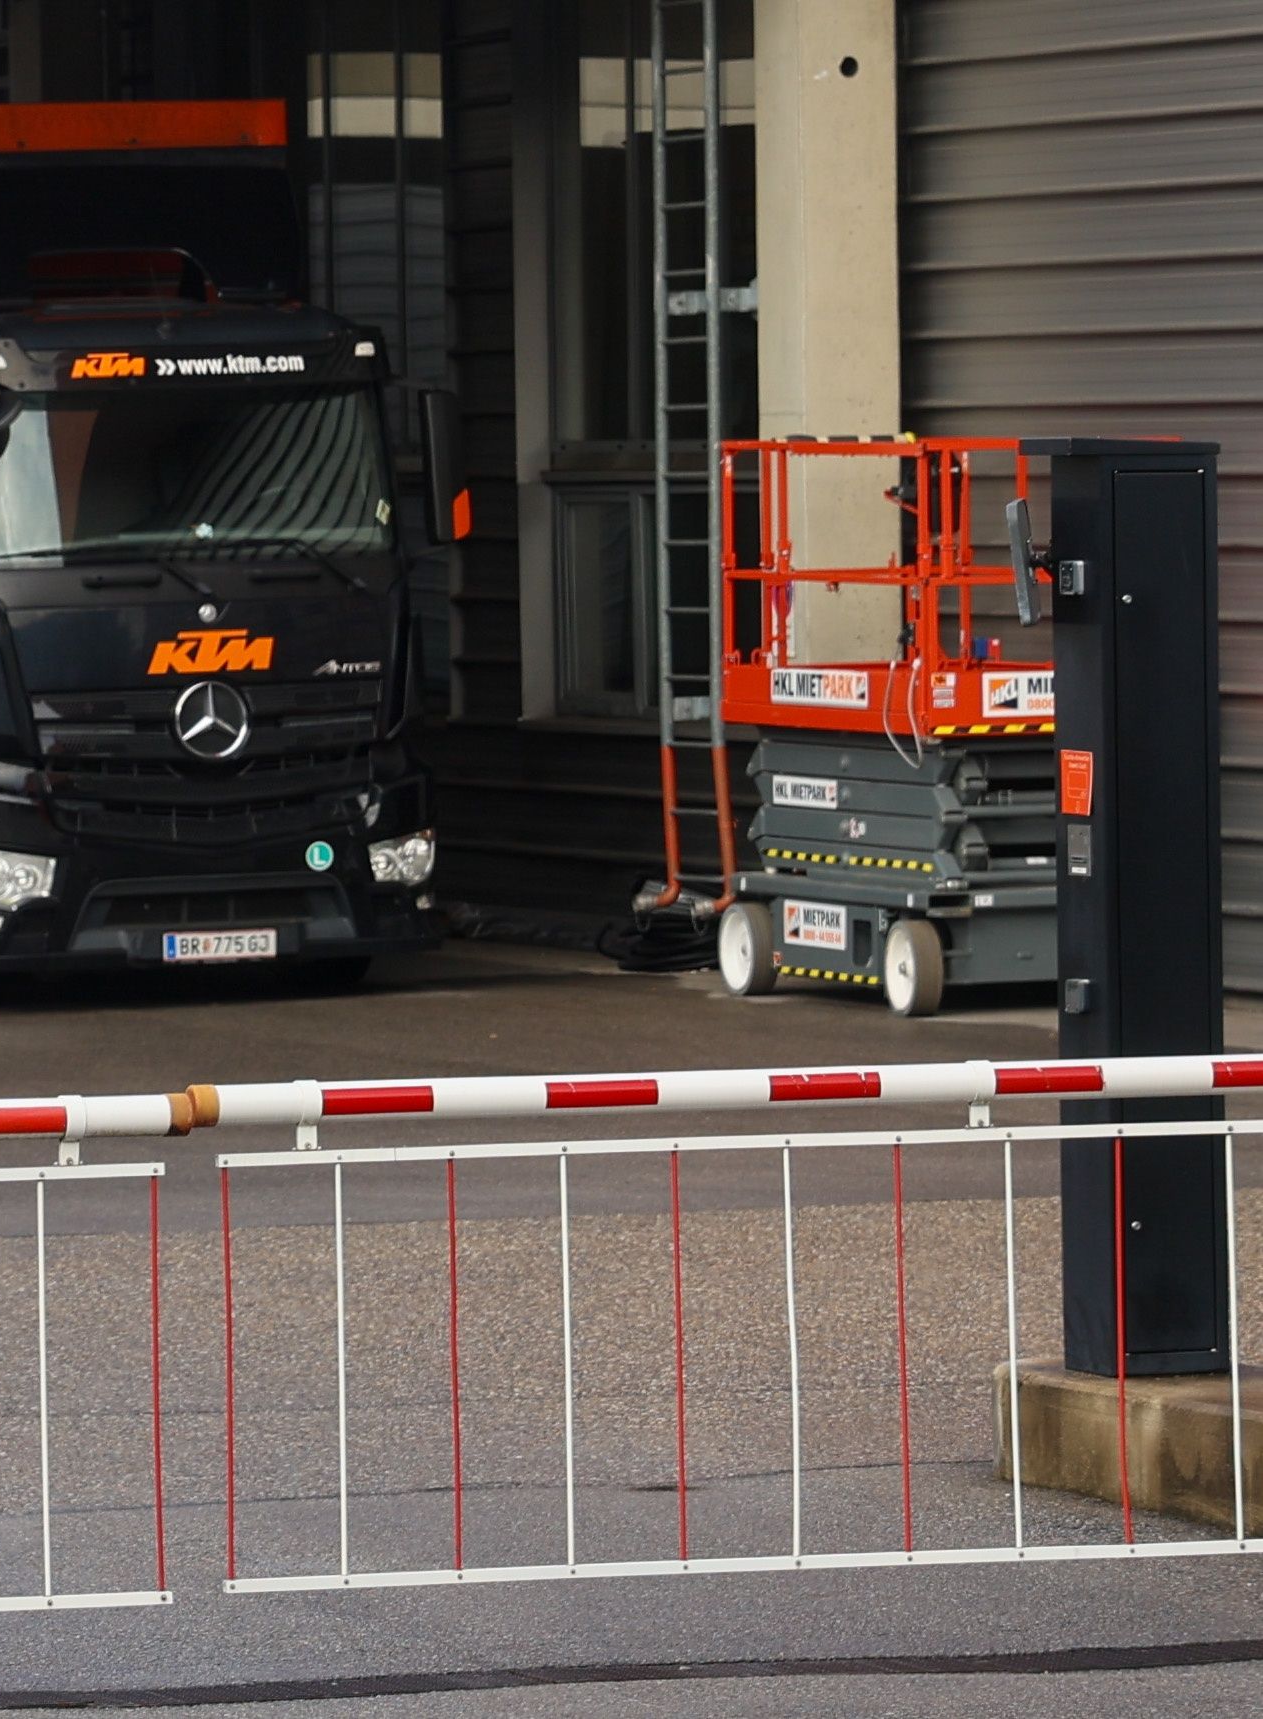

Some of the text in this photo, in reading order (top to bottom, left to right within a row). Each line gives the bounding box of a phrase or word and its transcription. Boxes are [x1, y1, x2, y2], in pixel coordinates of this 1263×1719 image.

[71, 352, 145, 379] KTM
[177, 354, 305, 376] www.ktm.com
[148, 629, 274, 675] KTM
[773, 672, 854, 700] HKL MIETPARK
[803, 909, 841, 928] MIETPARK
[179, 937, 200, 956] BR
